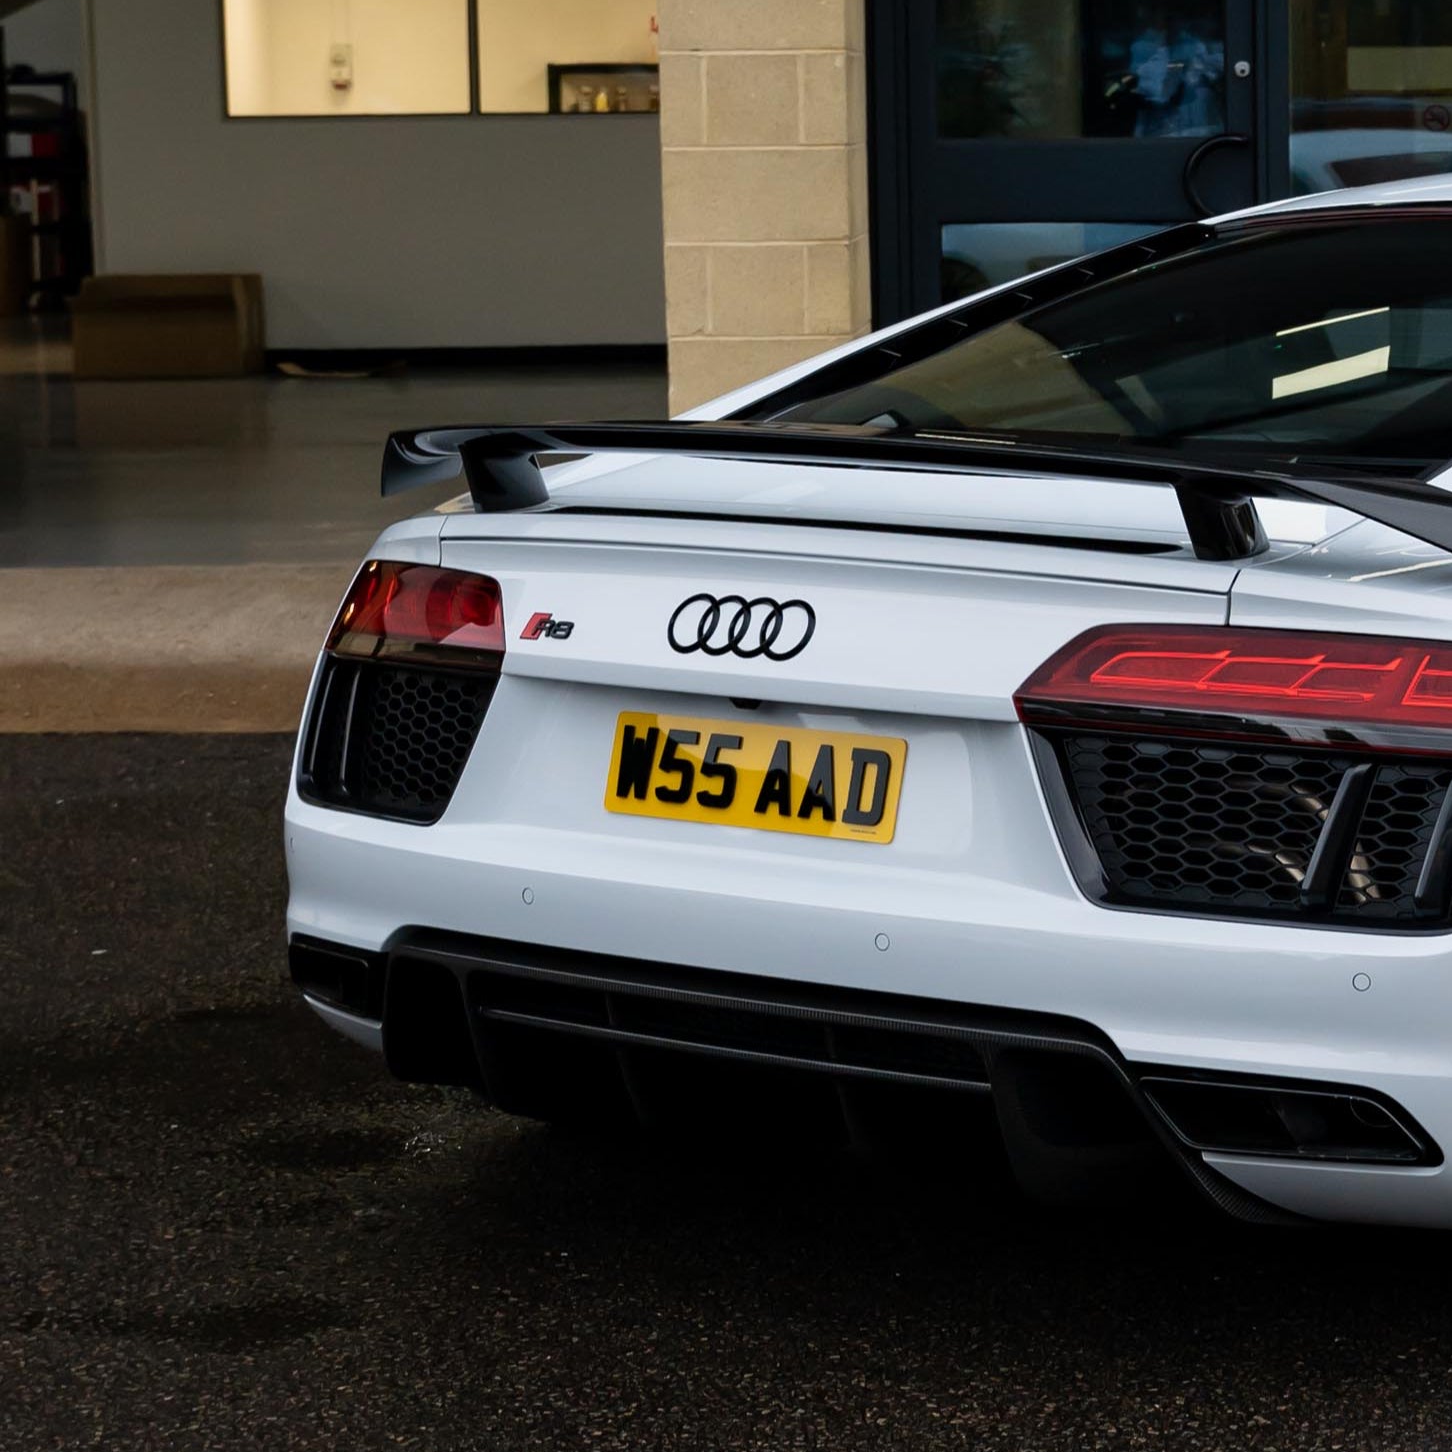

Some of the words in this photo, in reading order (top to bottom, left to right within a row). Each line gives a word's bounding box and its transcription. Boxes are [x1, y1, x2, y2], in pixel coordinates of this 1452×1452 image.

[528, 616, 575, 640] R8
[616, 725, 743, 809] W55
[754, 739, 891, 827] AAD
